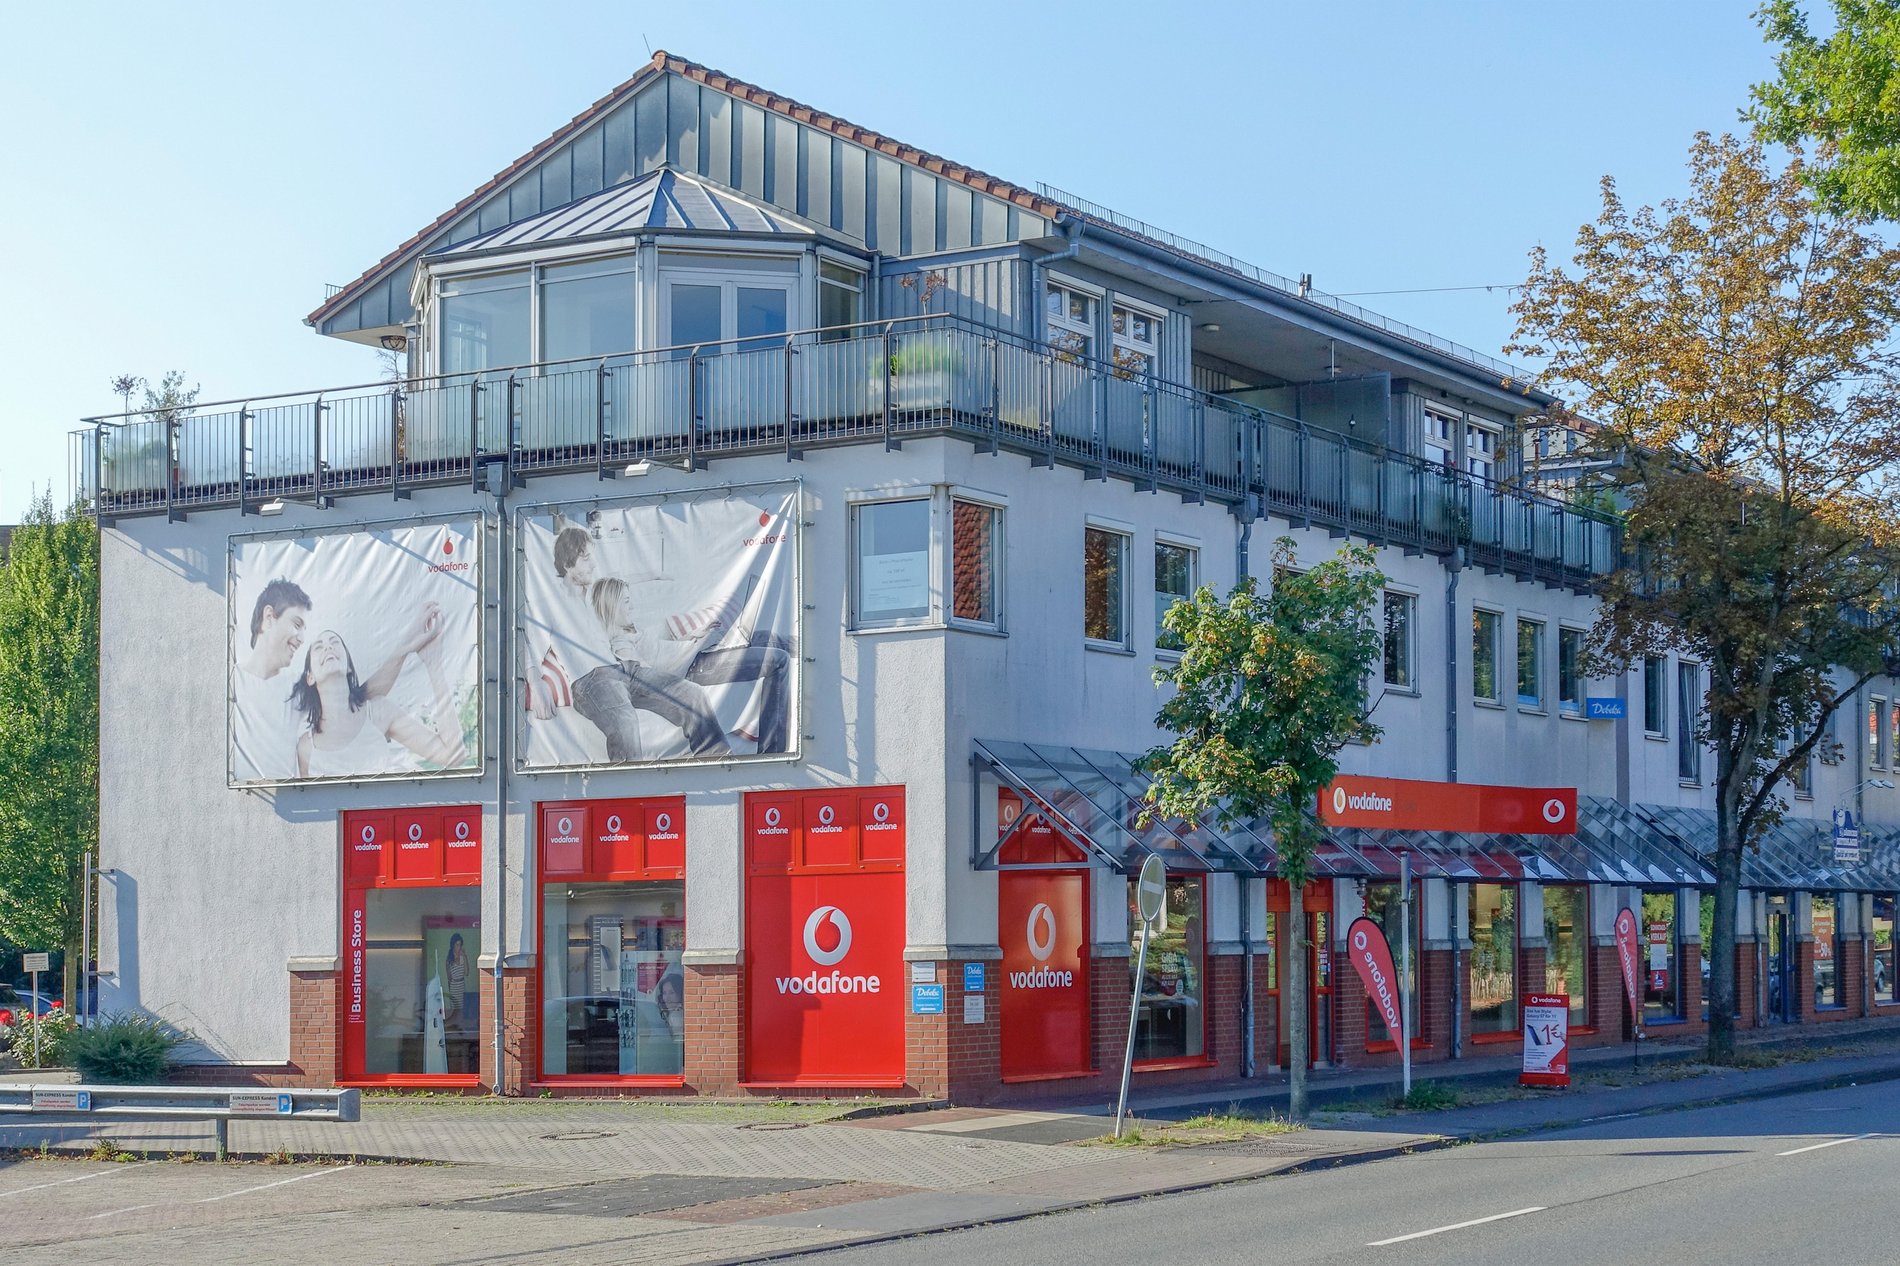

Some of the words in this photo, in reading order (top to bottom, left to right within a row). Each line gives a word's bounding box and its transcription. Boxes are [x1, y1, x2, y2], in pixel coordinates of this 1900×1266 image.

[428, 562, 468, 573] vodafone
[1592, 703, 1622, 715] Debeka
[1347, 791, 1392, 811] vodafone
[757, 826, 789, 835] vodafone
[811, 824, 843, 833] vodafone
[865, 822, 898, 831] vodafone
[550, 835, 580, 844] vodafone
[599, 833, 629, 842] vodafone
[648, 831, 679, 840] vodafone
[354, 843, 382, 851] vodafone
[401, 840, 430, 849] vodafone
[448, 839, 477, 848] vodafone
[351, 909, 362, 947] Store
[351, 950, 362, 1013] Business
[1009, 965, 1073, 989] vodafone
[775, 970, 881, 994] vodafone
